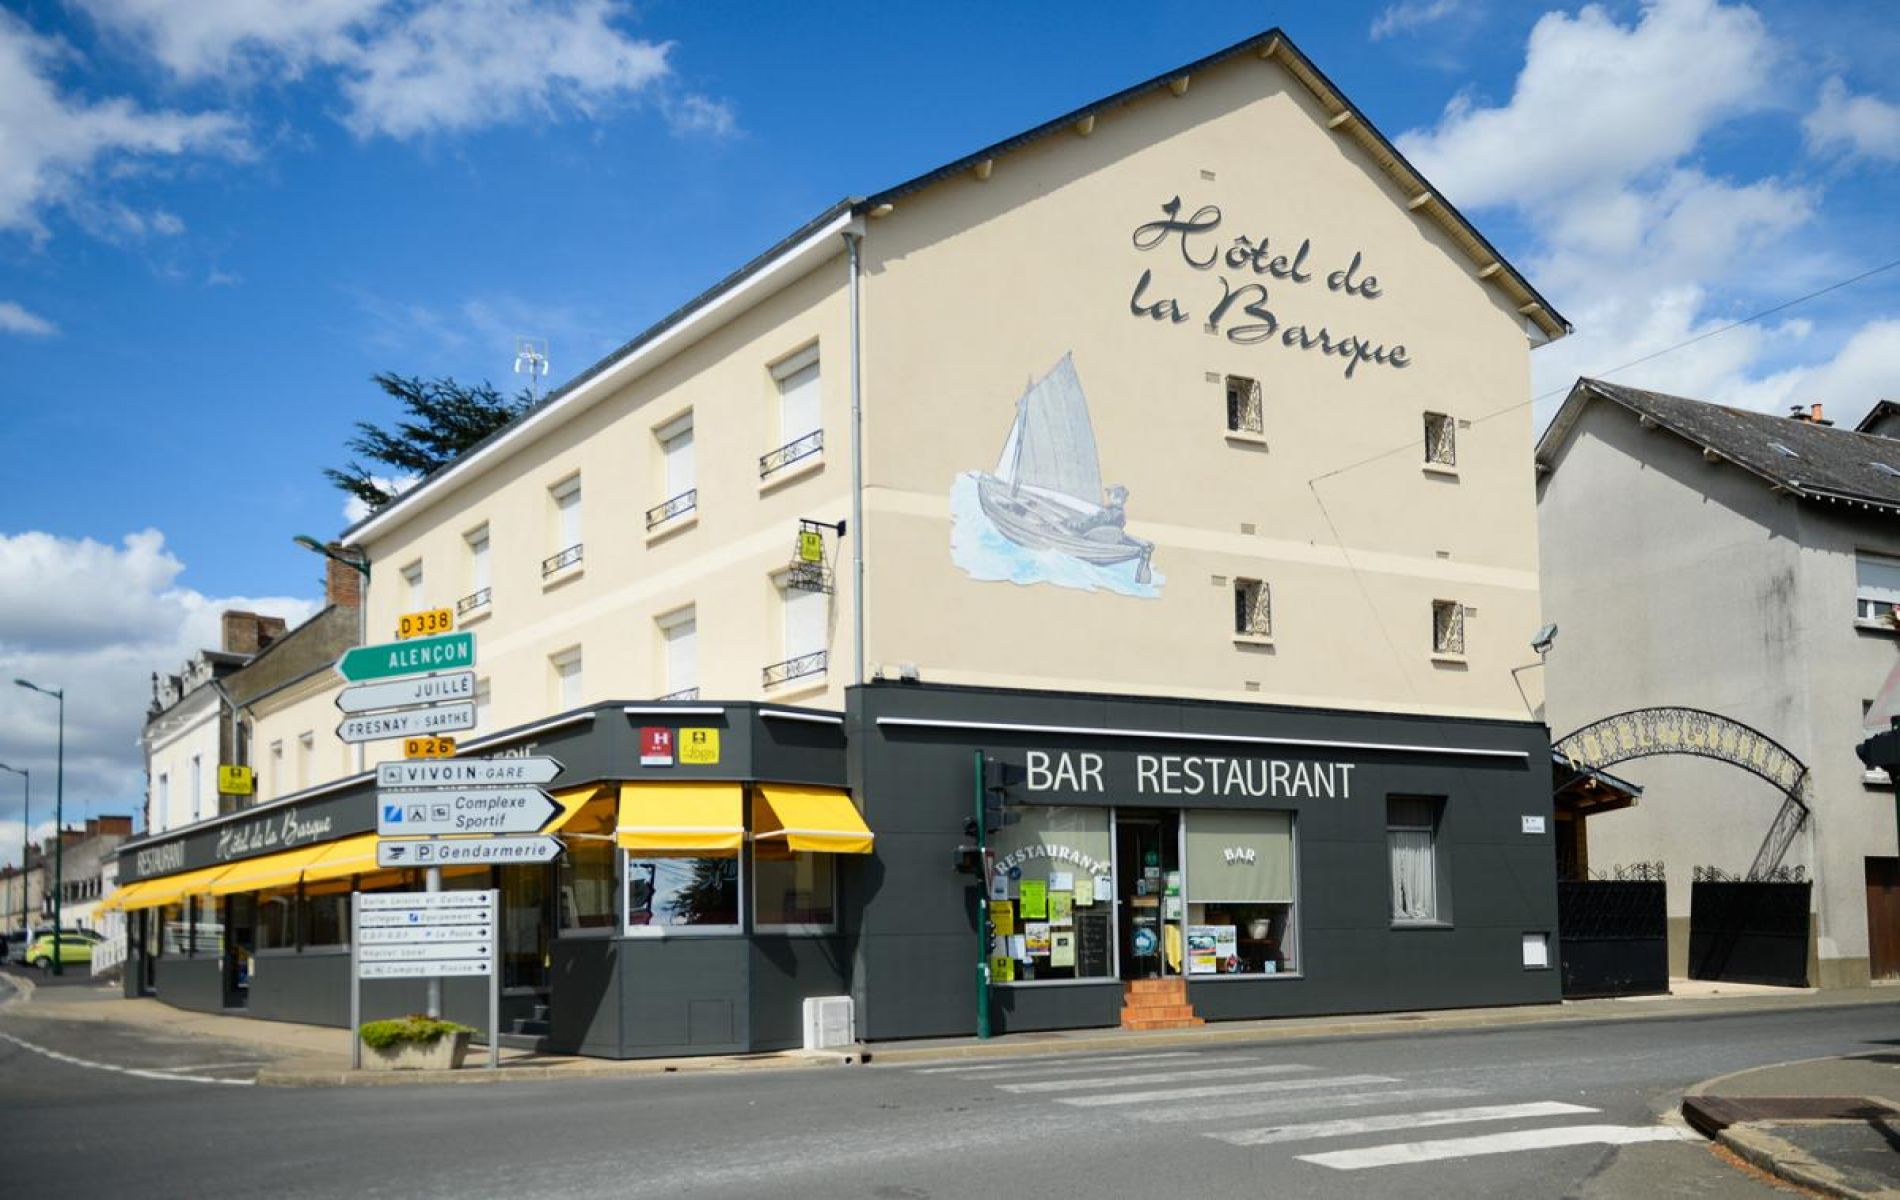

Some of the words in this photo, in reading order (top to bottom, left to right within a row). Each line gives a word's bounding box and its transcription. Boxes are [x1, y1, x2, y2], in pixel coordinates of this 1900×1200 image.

[1133, 195, 1312, 283] Hôtel
[1327, 251, 1383, 299] de
[1131, 268, 1189, 324] la
[1209, 275, 1412, 380] Barque
[401, 618, 411, 634] D
[417, 612, 448, 632] 338
[388, 641, 468, 669] ALENÇON
[415, 676, 468, 697] JUILLÉ
[347, 716, 408, 735] FRESNAY
[425, 711, 468, 727] SARTHE
[409, 742, 419, 754] D
[425, 741, 450, 754] 26
[408, 767, 476, 780] VIVOIN
[485, 767, 524, 778] GARE
[1026, 750, 1104, 792] BAR
[1136, 755, 1355, 798] RESTAURANT
[455, 796, 527, 811] Complexe
[455, 814, 506, 830] Sportif
[137, 840, 185, 876] RESTAURANT
[282, 807, 332, 846] Barque
[439, 844, 547, 860] Gendarmerie
[996, 843, 1101, 875] RESTAURANT
[1223, 847, 1256, 863] BAR
